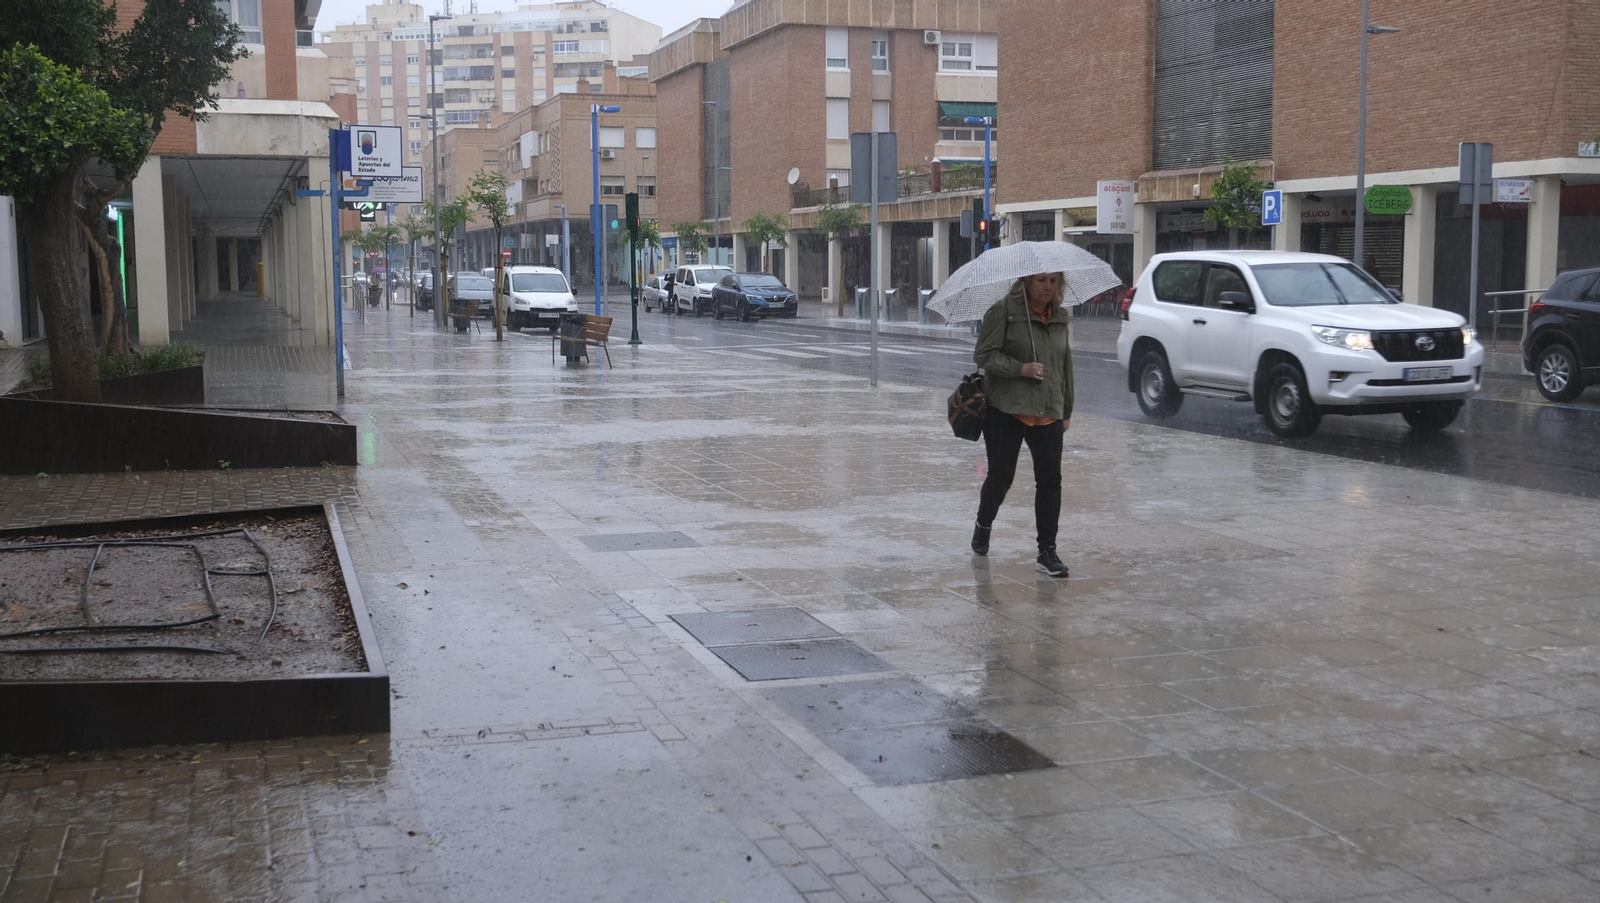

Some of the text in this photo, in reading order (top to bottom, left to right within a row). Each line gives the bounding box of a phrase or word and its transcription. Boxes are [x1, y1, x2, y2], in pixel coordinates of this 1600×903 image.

[1370, 188, 1408, 198] Congelados
[1265, 195, 1276, 220] P
[1368, 198, 1410, 210] ICEBERG
